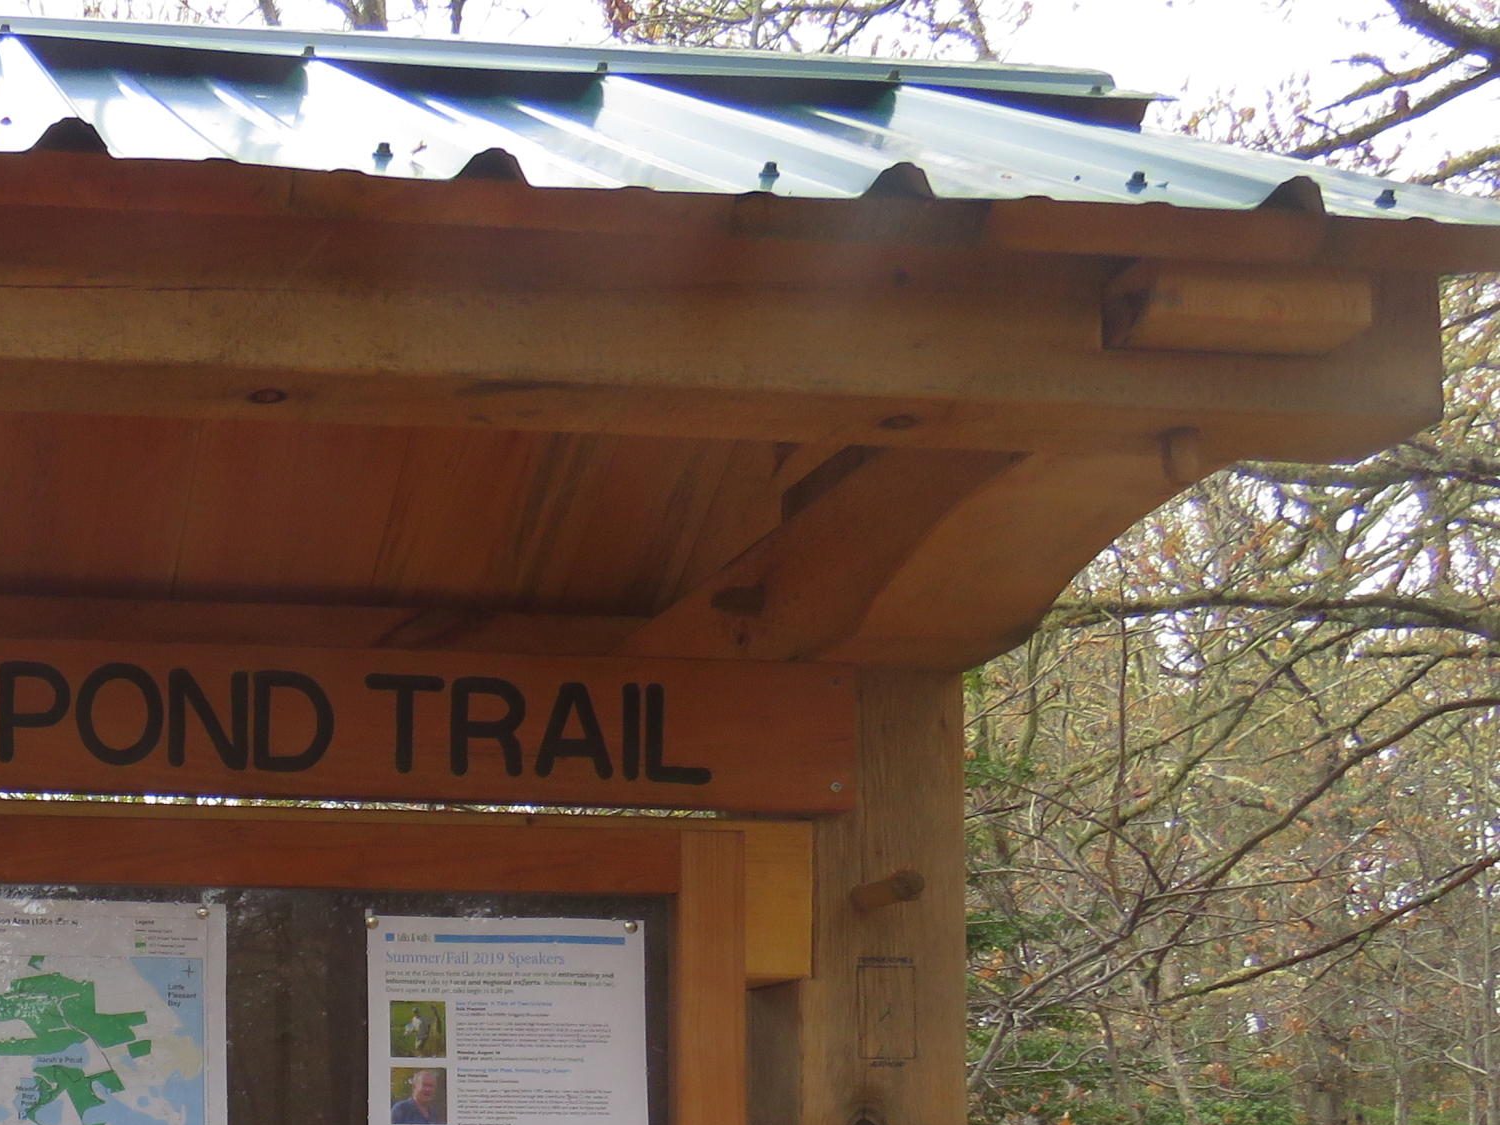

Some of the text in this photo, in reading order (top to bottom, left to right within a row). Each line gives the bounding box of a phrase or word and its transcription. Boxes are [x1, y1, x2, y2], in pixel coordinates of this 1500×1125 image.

[364, 673, 712, 787] TRAIL
[386, 951, 565, 968] Summer/Fall 2019 Speakers
